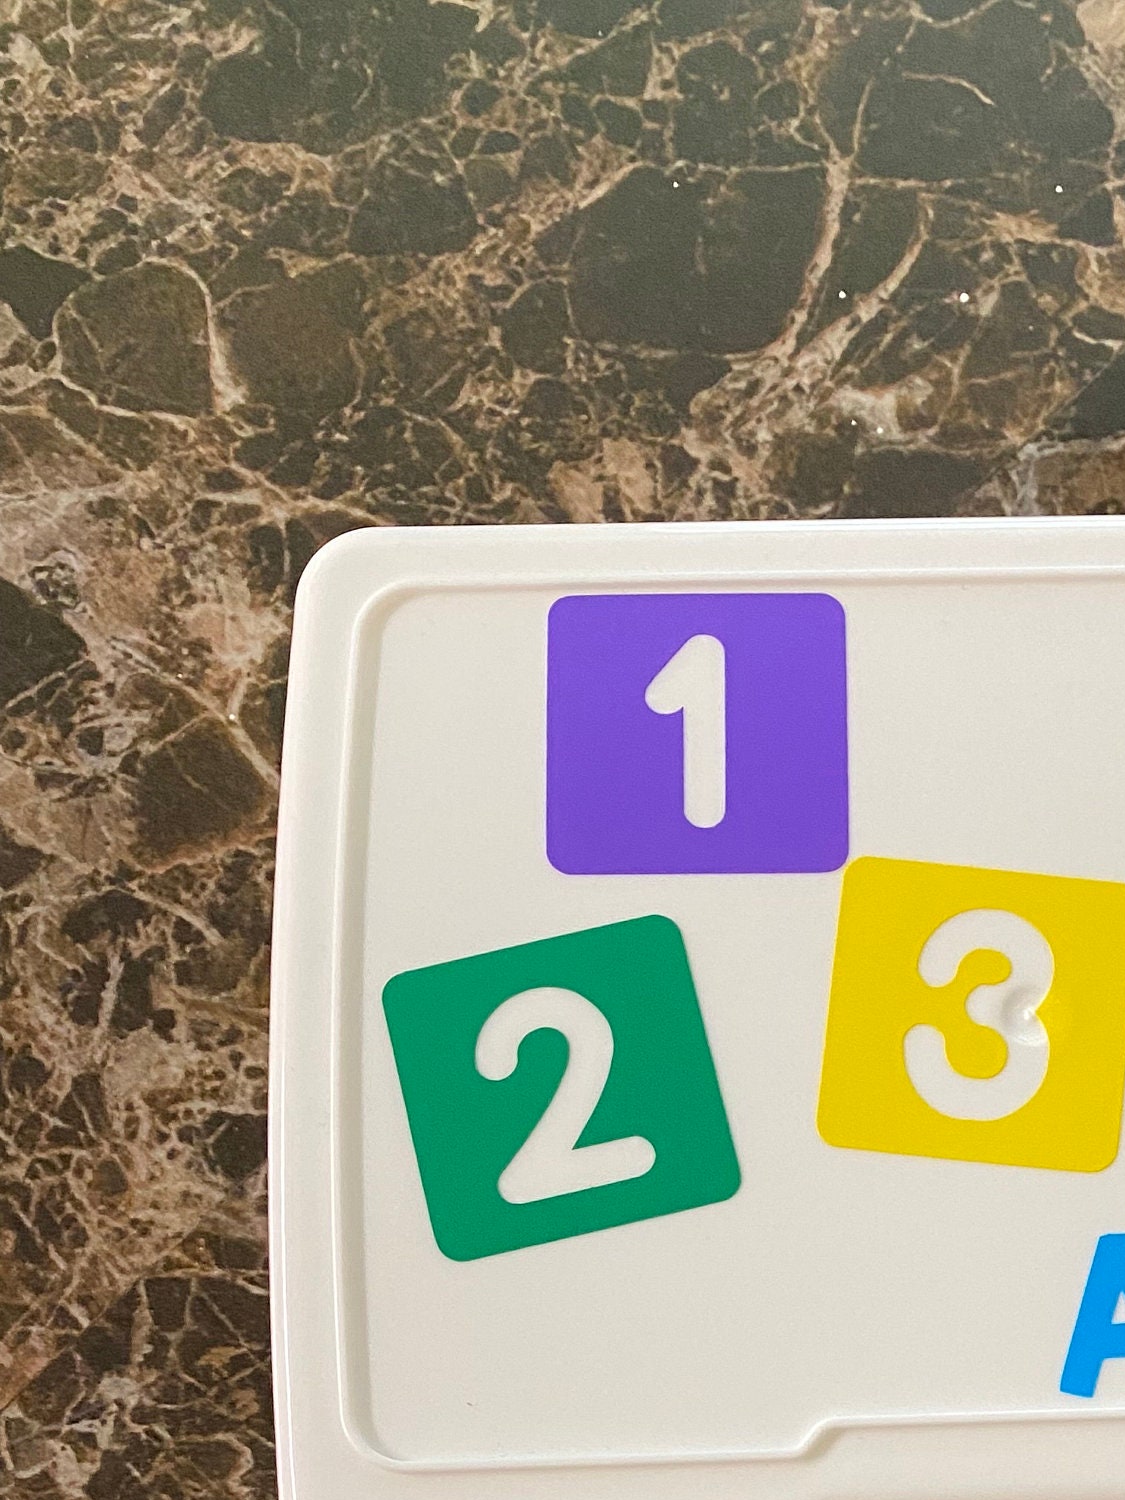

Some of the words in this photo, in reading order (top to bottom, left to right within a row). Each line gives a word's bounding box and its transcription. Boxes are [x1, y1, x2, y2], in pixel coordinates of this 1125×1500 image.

[646, 635, 726, 829] 1
[475, 986, 656, 1204] 2
[904, 909, 1054, 1121] 3
